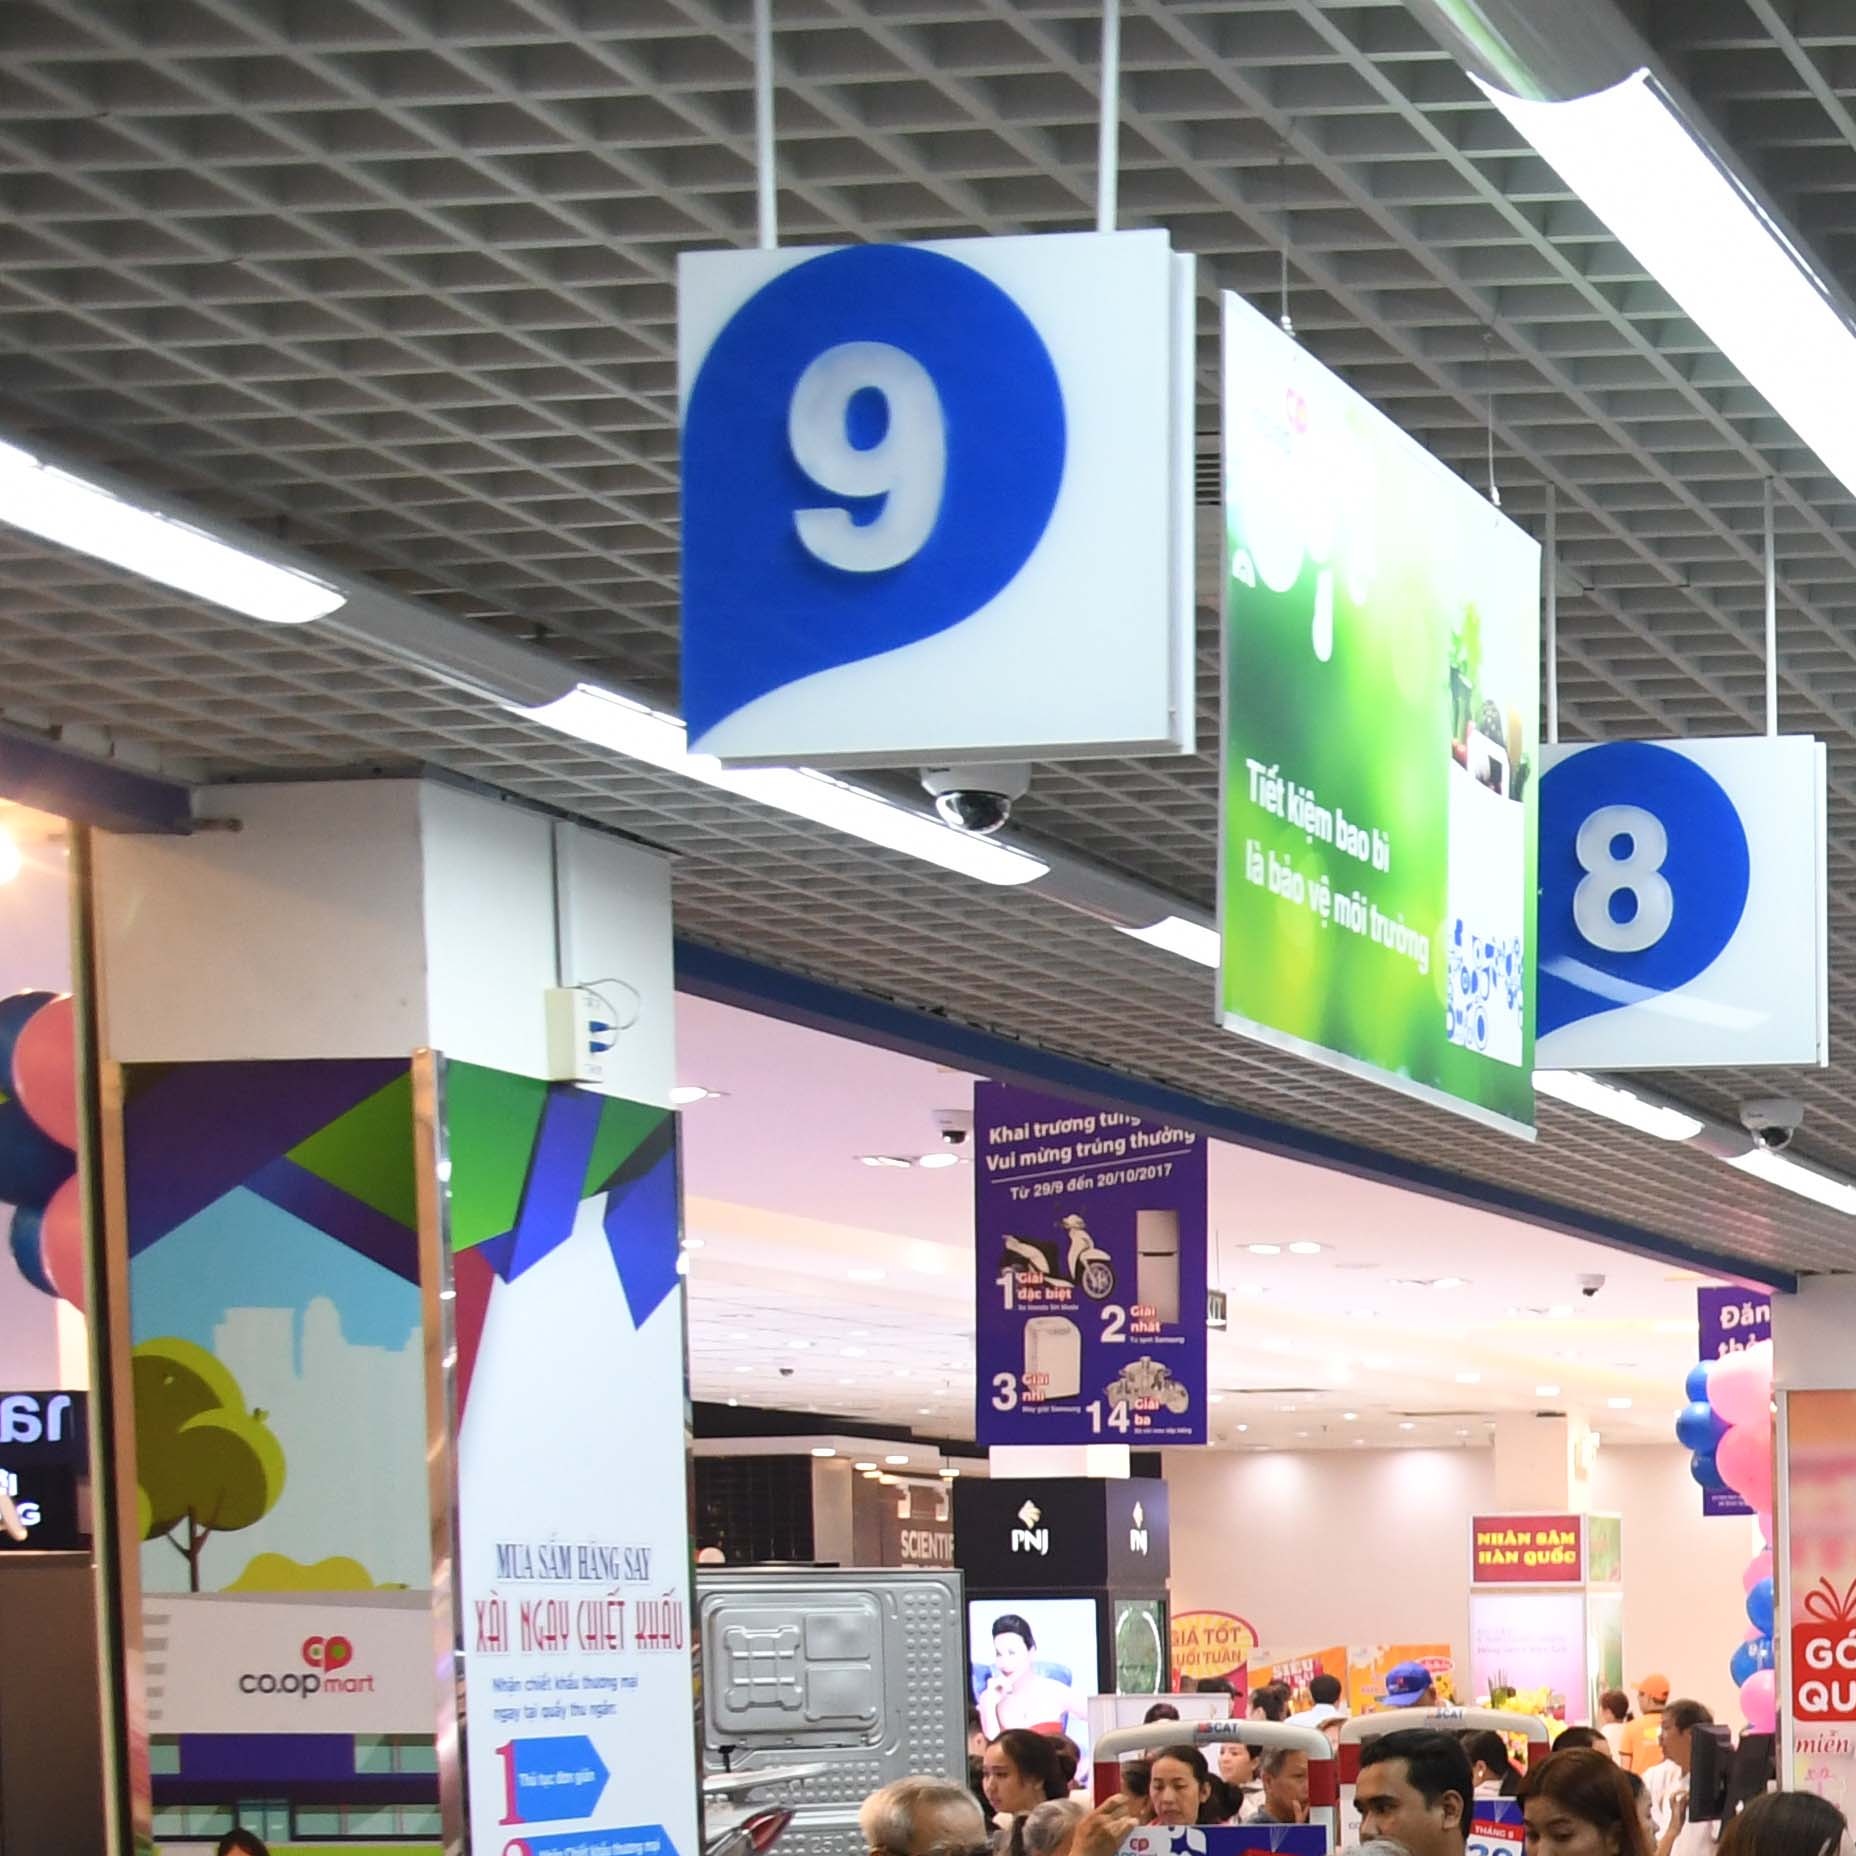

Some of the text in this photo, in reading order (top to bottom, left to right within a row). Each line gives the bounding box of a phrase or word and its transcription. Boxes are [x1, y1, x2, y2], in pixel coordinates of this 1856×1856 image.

[788, 340, 946, 572] 9
[1246, 758, 1390, 872] Tiết kiệm bao bì
[1573, 805, 1673, 952] 8
[1245, 839, 1429, 975] là bảo vệ môi trường
[989, 1115, 1096, 1145] Khai trương
[986, 1148, 1016, 1171] Vui
[1020, 1141, 1072, 1168] mừng
[1075, 1133, 1126, 1163] trúng
[1011, 1163, 1173, 1201] Từ 29/9 đến 20/10/2017
[996, 1272, 1014, 1310] 1
[1100, 1304, 1126, 1343] 2
[992, 1372, 1017, 1412] 3
[1086, 1400, 1130, 1434] 14
[1134, 1413, 1151, 1426] ba
[1011, 1528, 1050, 1557] PNJ
[1477, 1529, 1531, 1547] NHÂN
[1478, 1546, 1576, 1567] HÀN QUỐC
[496, 1543, 534, 1580] MUA
[538, 1533, 572, 1580] SẮM
[624, 1546, 652, 1582] SAY
[519, 1599, 570, 1653] NGAY
[576, 1586, 627, 1652] CHIẾT
[635, 1585, 685, 1651] KHẤU
[1204, 1620, 1242, 1646] TỐT
[1796, 1730, 1850, 1754] miễn
[495, 1740, 526, 1827] 1
